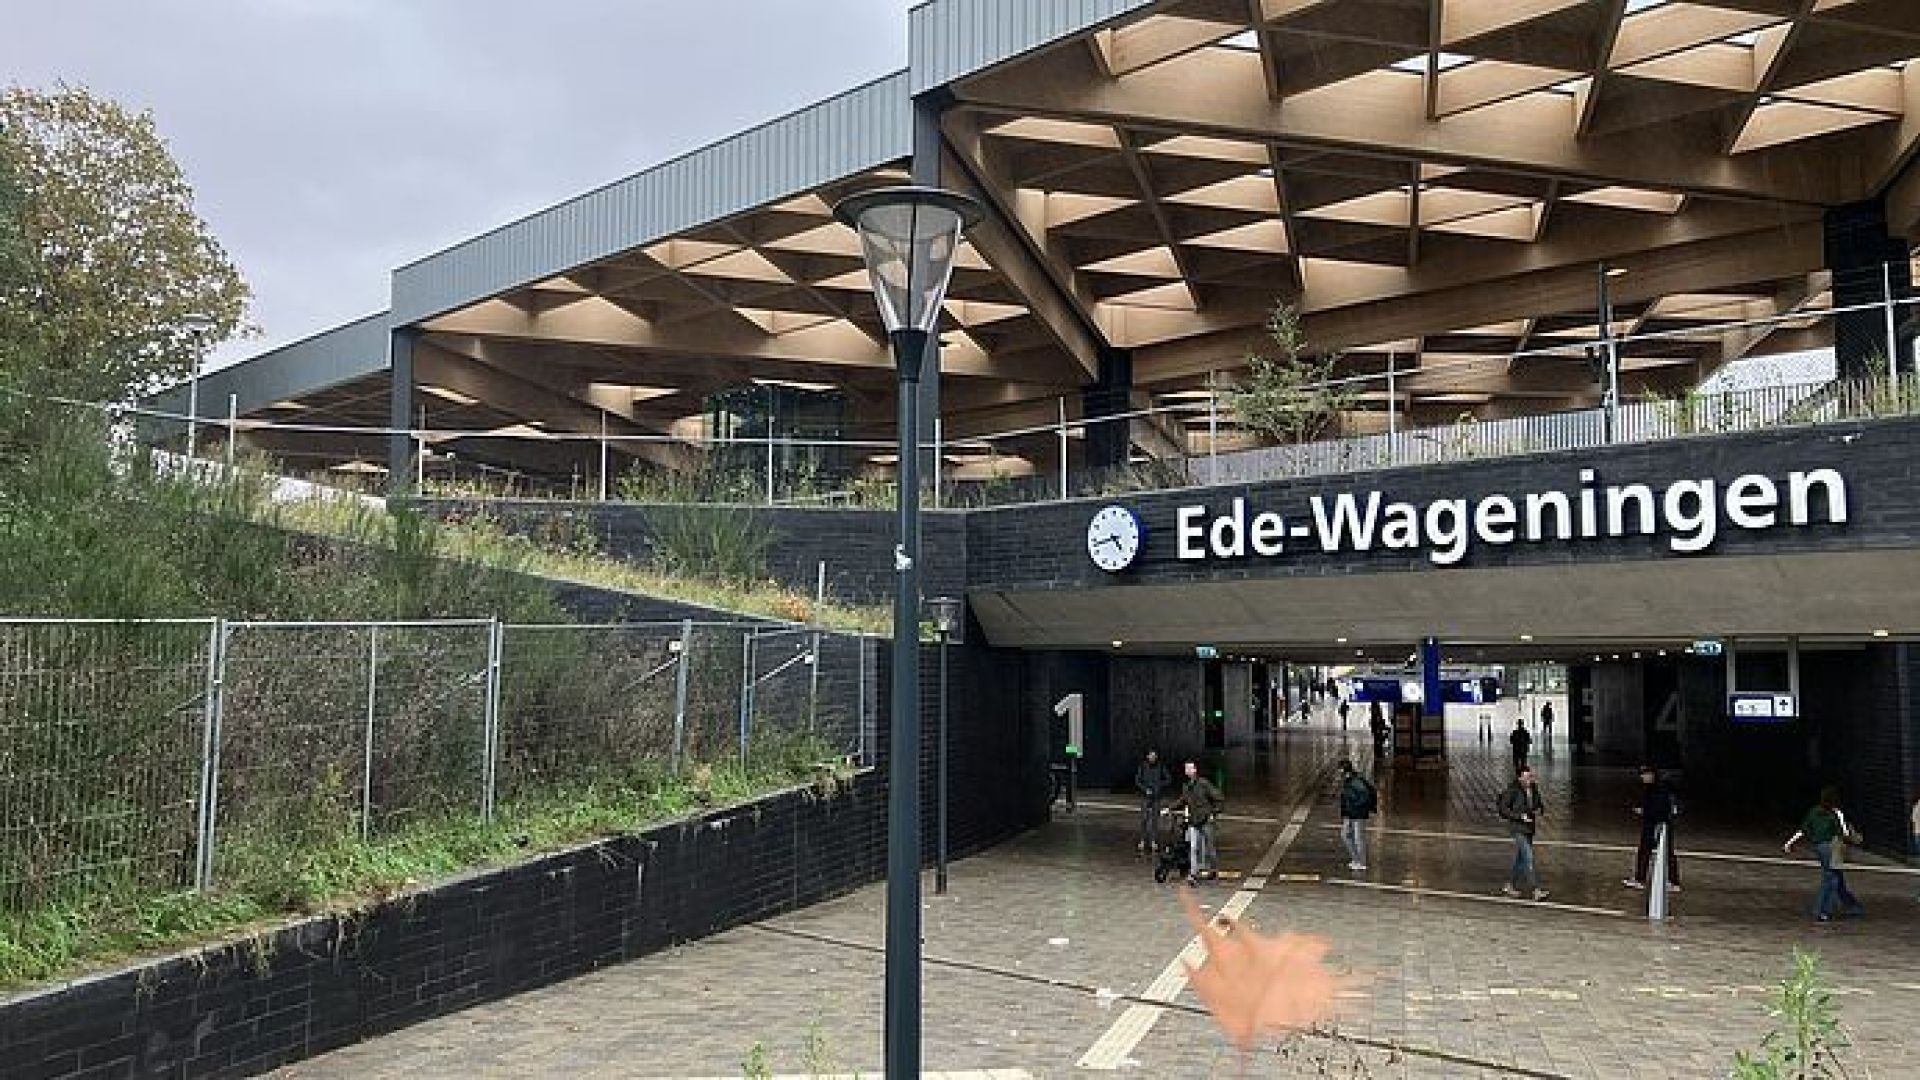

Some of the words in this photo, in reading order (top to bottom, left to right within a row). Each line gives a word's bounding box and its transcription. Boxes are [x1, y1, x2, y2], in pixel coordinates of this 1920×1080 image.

[1177, 468, 1847, 564] Ede-Wageningen
[1054, 693, 1084, 758] 1
[1655, 690, 1688, 743] 4
